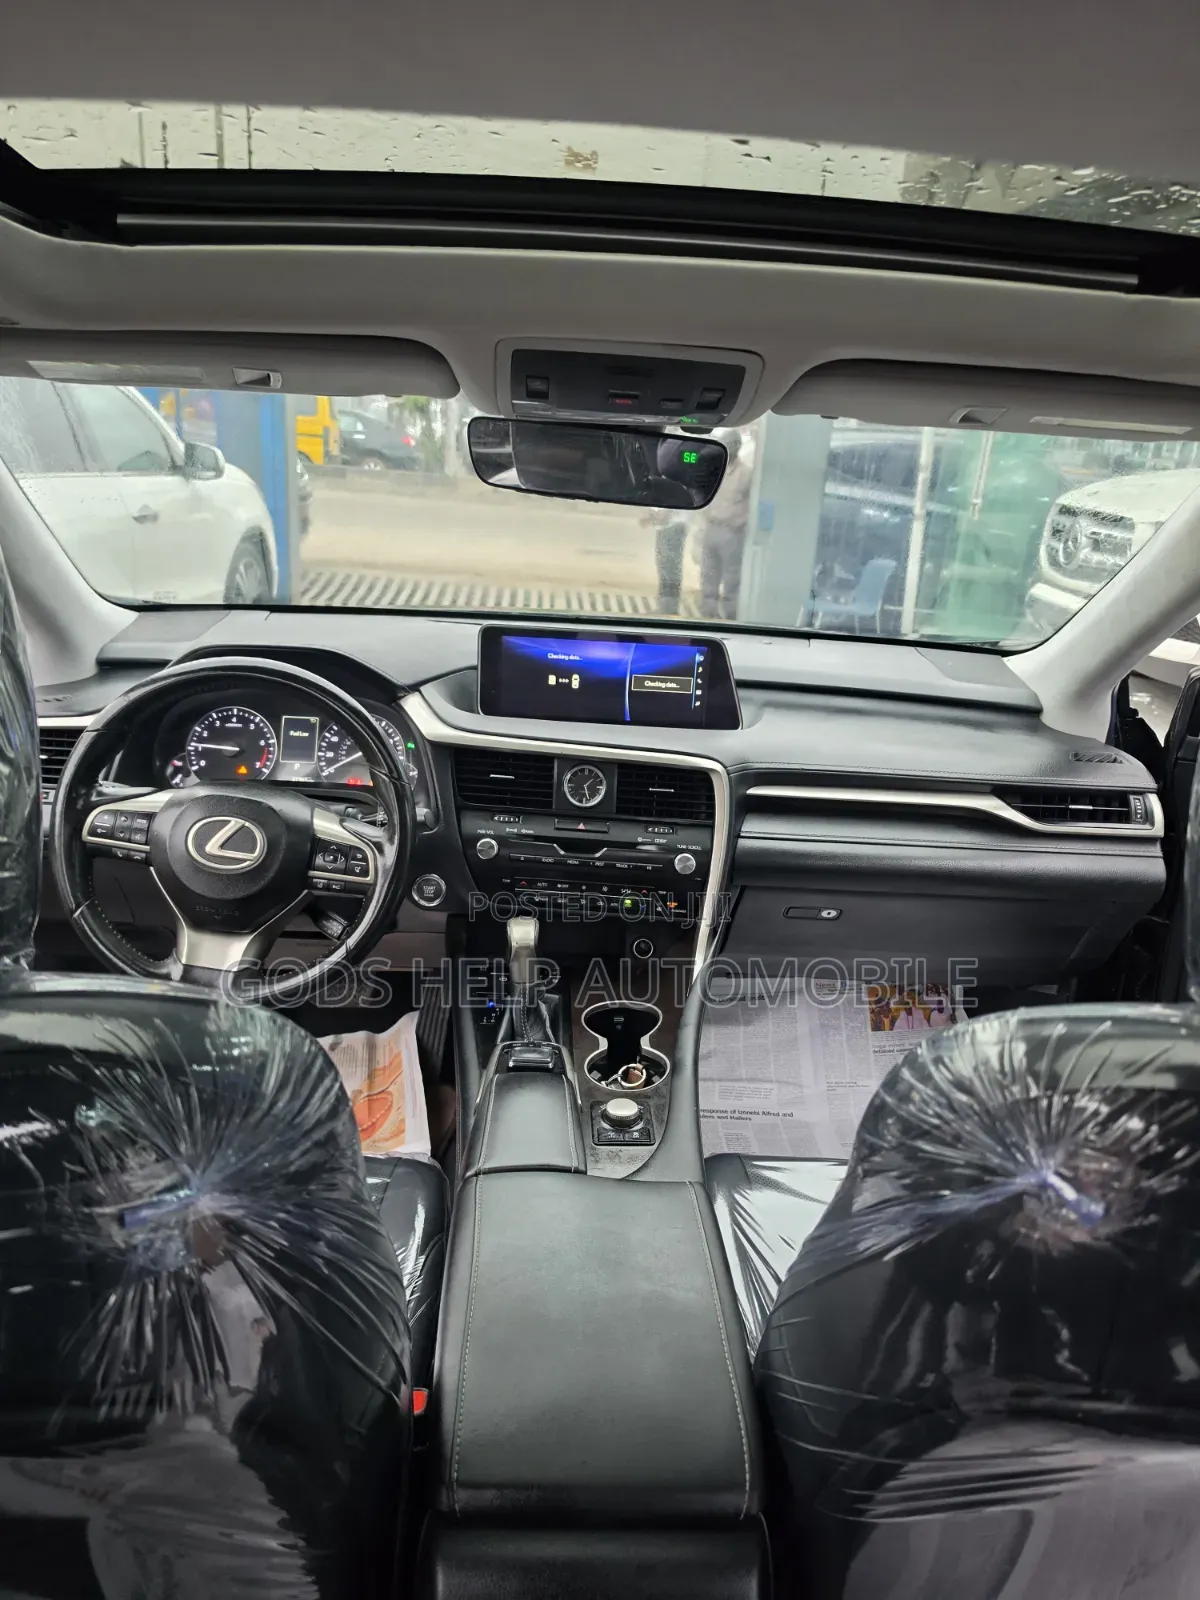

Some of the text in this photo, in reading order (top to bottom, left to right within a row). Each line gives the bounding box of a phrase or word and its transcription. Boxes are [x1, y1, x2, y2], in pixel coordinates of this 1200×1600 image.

[683, 452, 697, 463] SE
[547, 652, 569, 661] Checking
[644, 680, 665, 689] Checking
